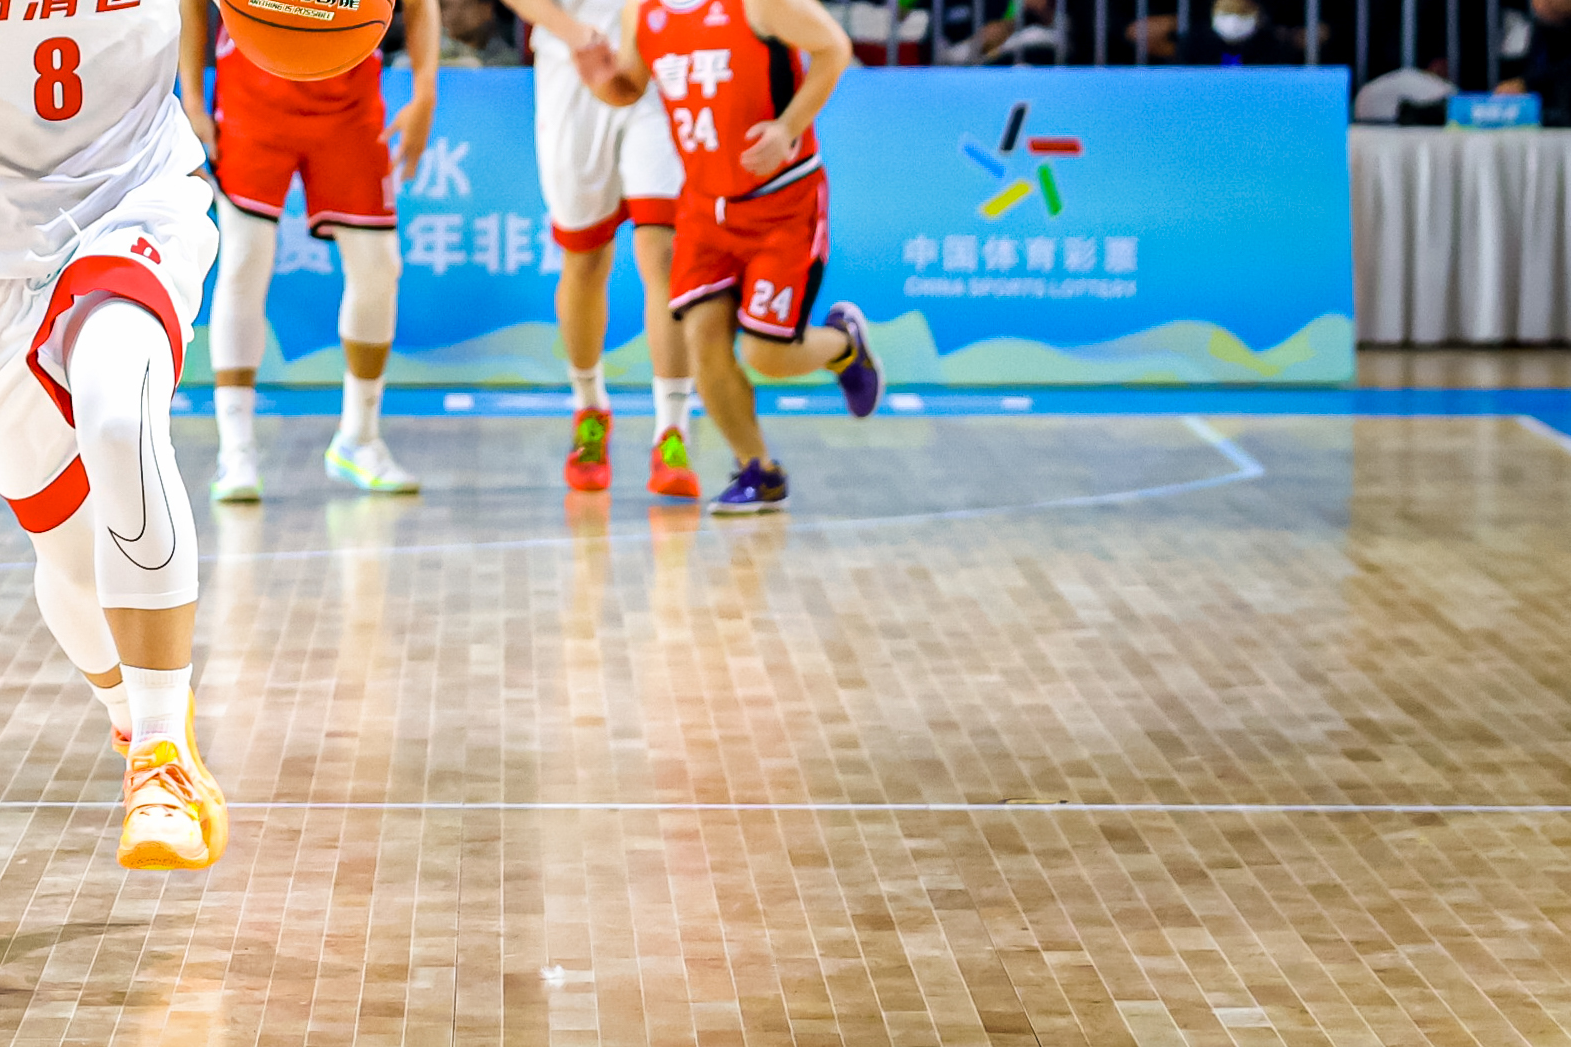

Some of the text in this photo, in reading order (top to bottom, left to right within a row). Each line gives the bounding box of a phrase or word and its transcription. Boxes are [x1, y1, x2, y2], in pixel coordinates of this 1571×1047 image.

[34, 37, 82, 121] 8
[673, 107, 720, 151] 24
[392, 137, 471, 198] 水
[902, 234, 1139, 273] 中国体育彩票
[748, 278, 793, 323] 24
